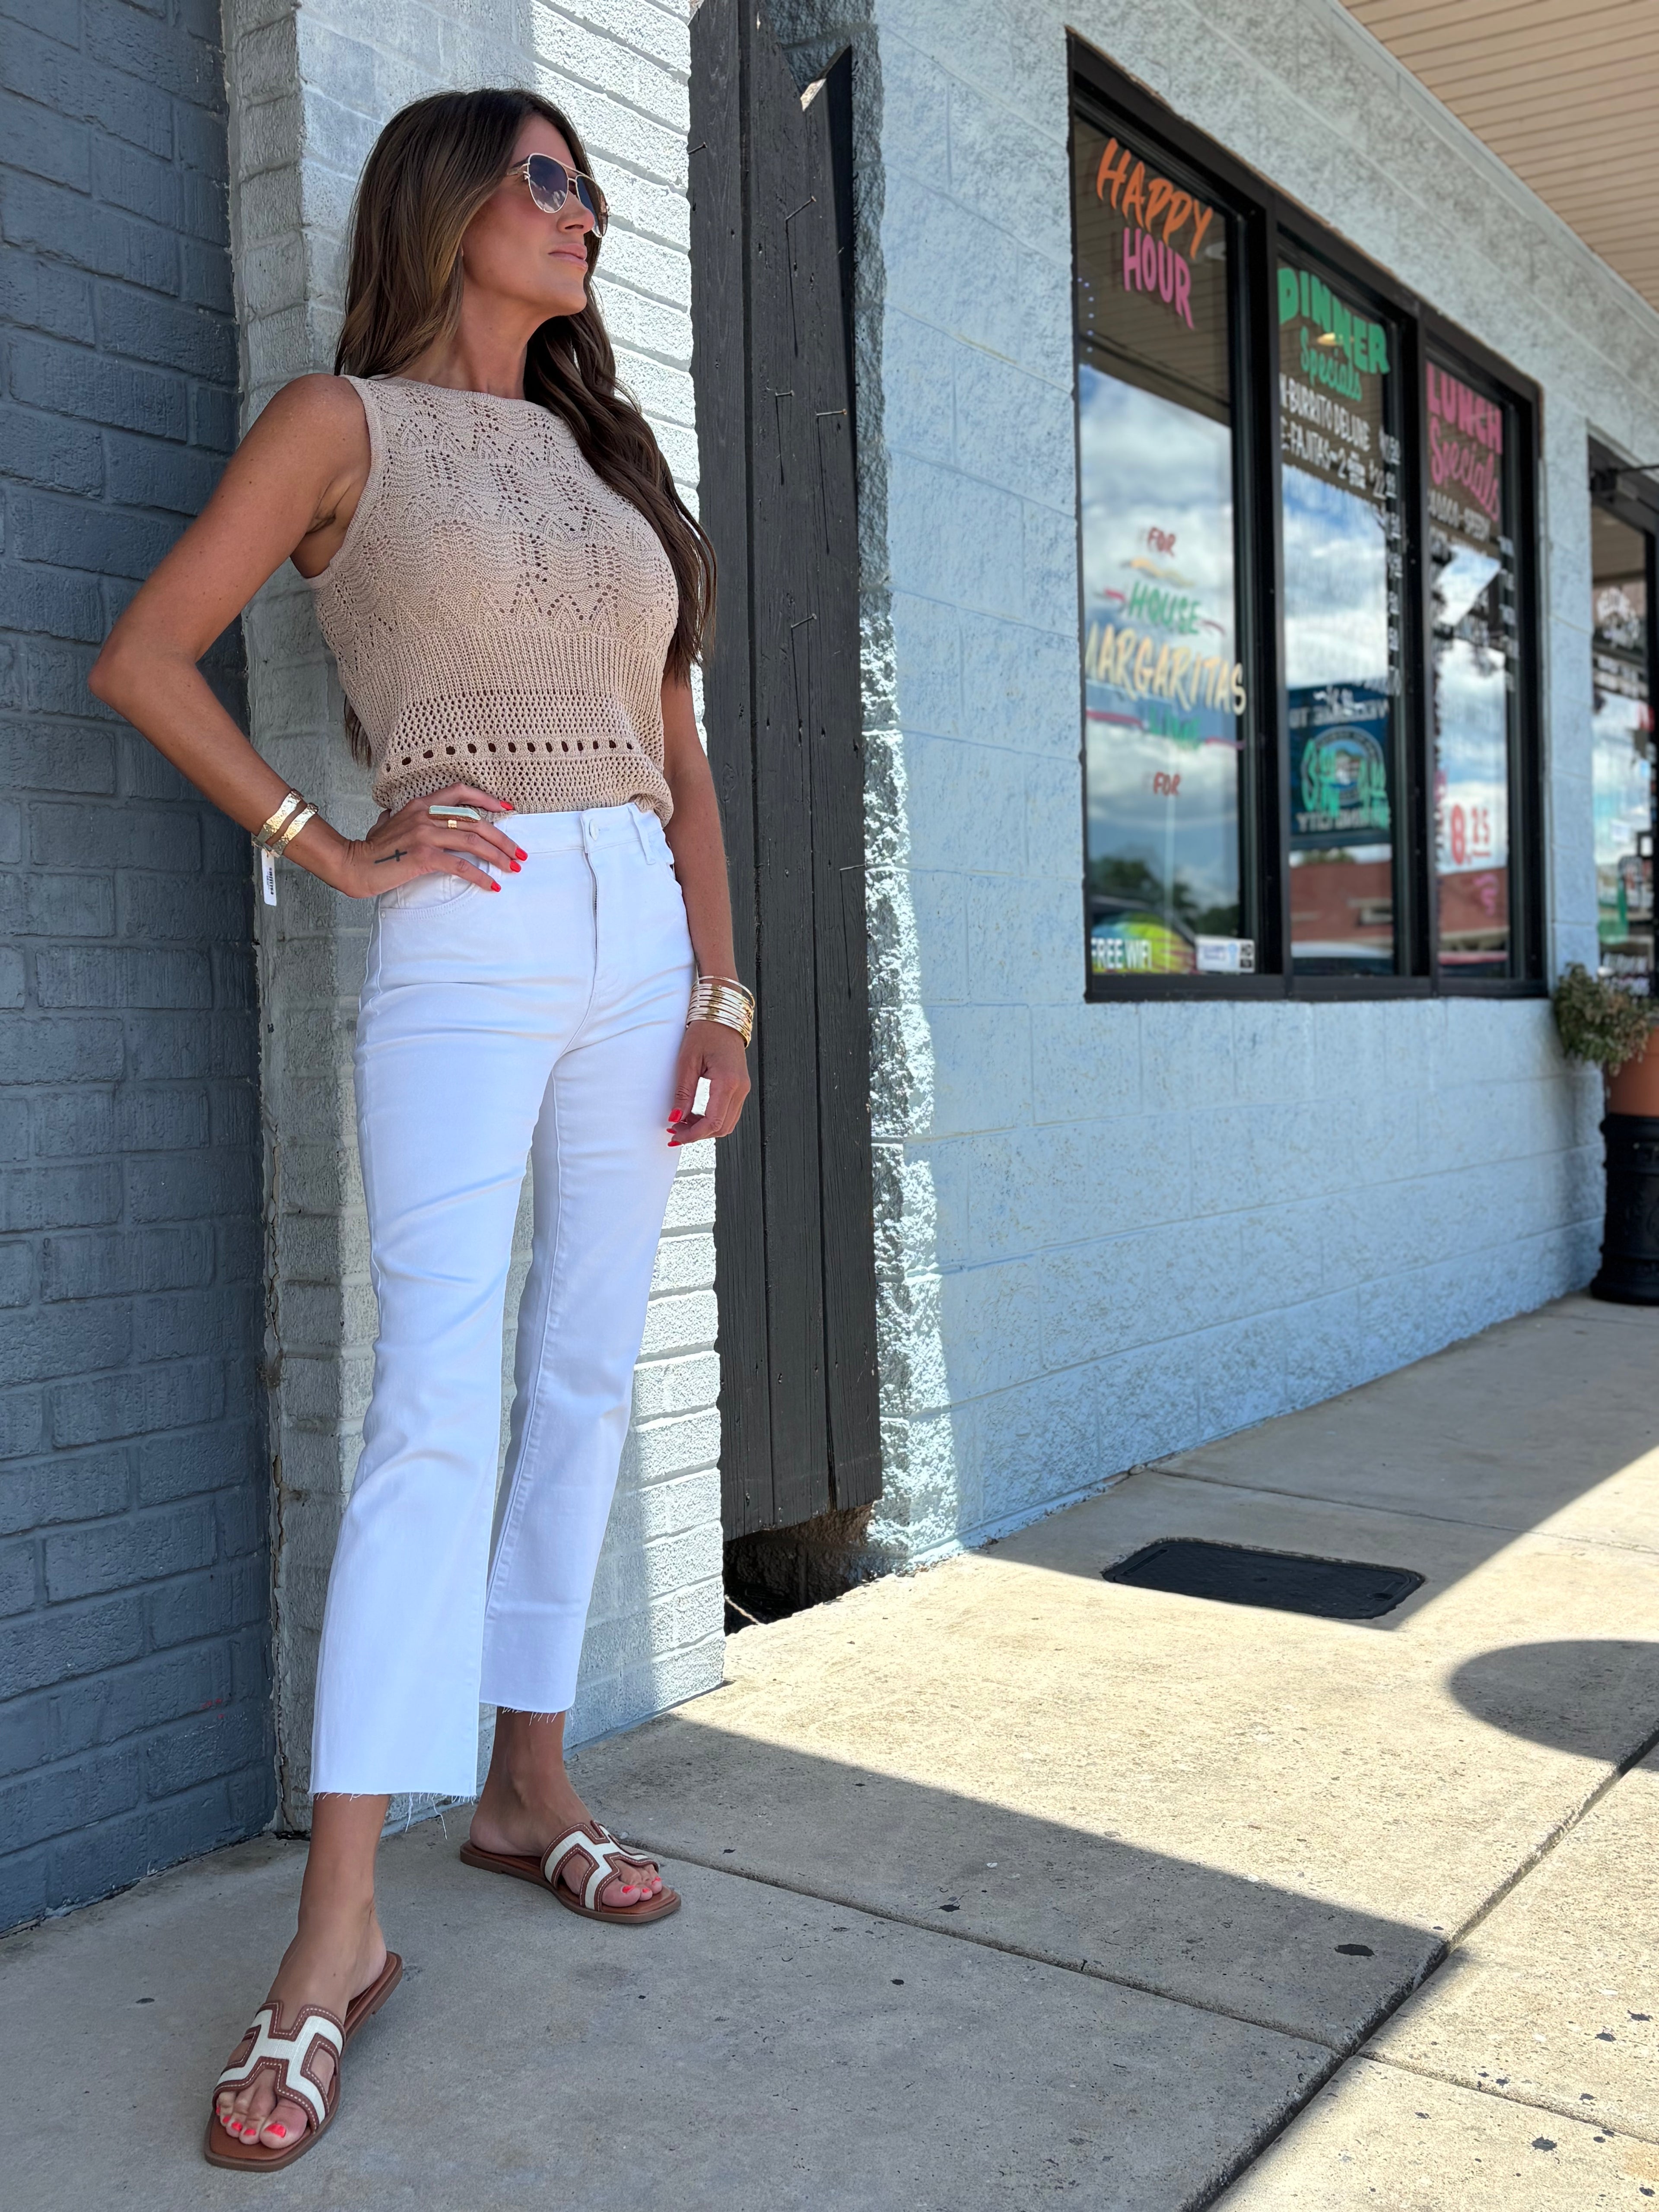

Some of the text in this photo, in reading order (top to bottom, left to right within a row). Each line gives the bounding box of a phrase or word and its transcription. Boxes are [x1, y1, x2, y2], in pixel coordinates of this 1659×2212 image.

[1096, 138, 1213, 260] HAPPY
[1124, 227, 1195, 331] HOUR
[1277, 267, 1390, 375] DINNER
[1300, 326, 1363, 403] Specials
[1427, 361, 1503, 456] LUNCH
[1429, 415, 1501, 522] Specials
[1147, 527, 1176, 557] FOR
[1126, 581, 1201, 635] HOUSE
[1153, 772, 1181, 796] FOR
[1091, 938, 1123, 969] FREE
